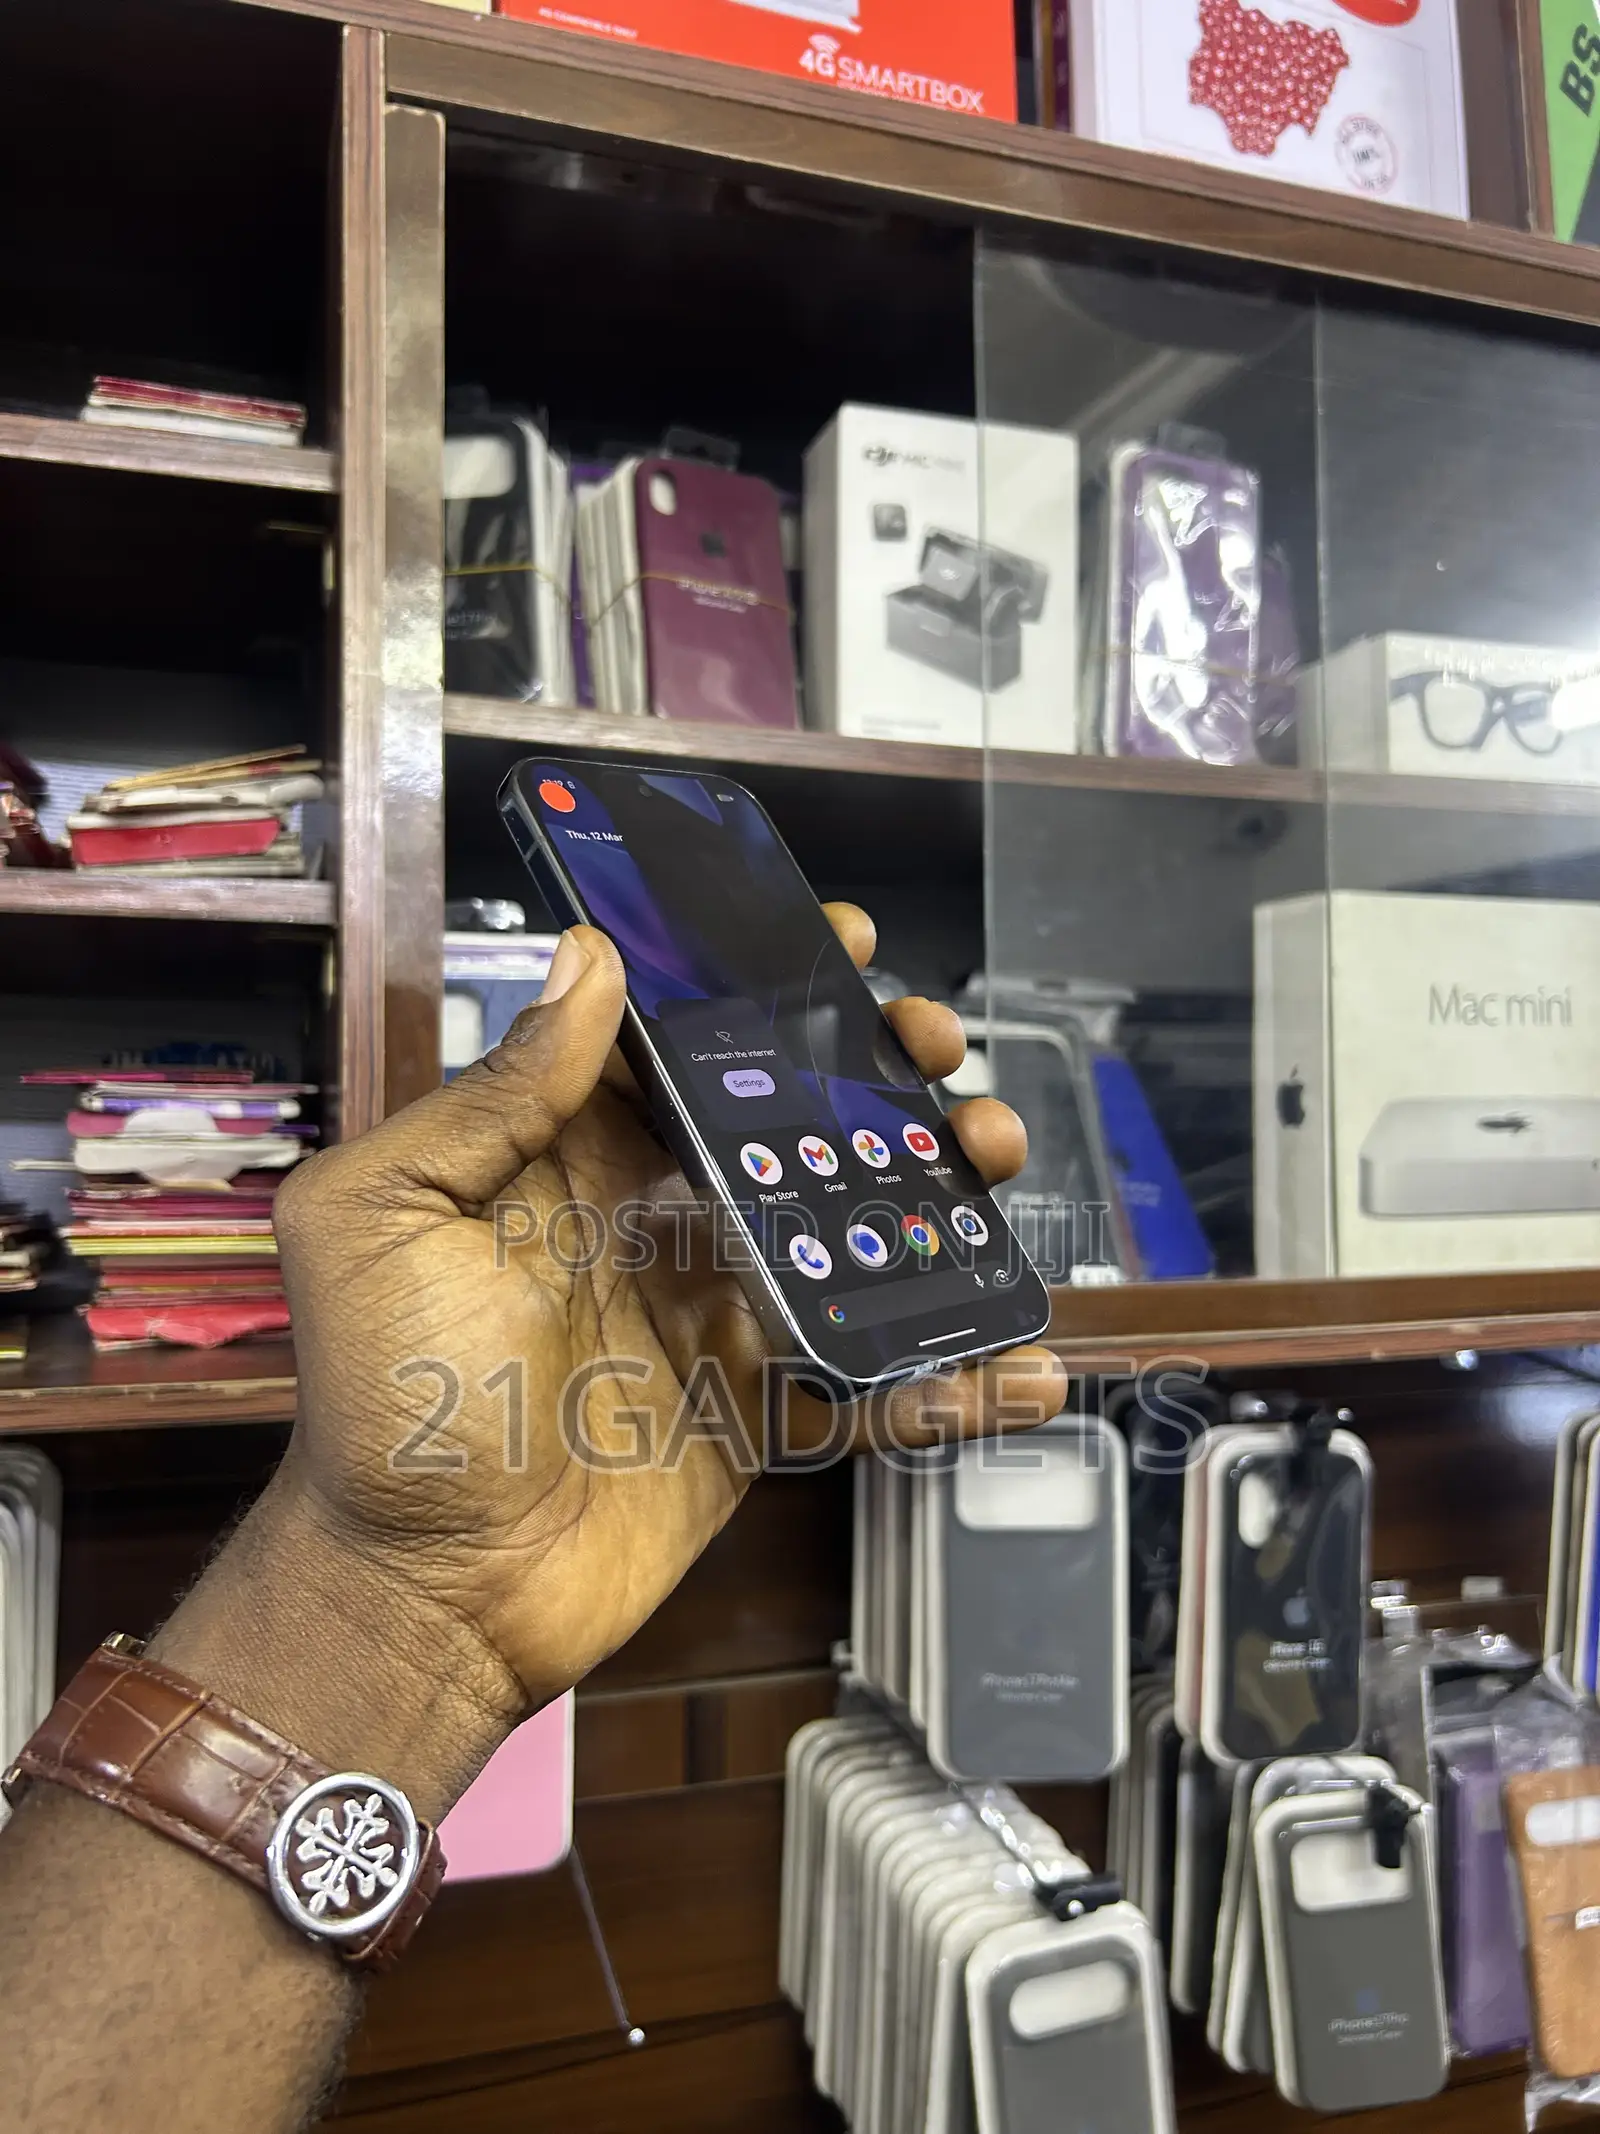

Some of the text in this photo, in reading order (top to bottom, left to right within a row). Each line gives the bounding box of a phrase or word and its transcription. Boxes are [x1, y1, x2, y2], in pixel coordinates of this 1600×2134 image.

[799, 48, 837, 79] 4G
[837, 55, 986, 114] SMARTBOX
[565, 829, 624, 842] Thu, 12 Mar
[1428, 982, 1574, 1028] Mac mini
[691, 1048, 777, 1062] Can't reach the internet
[732, 1079, 766, 1088] Settings
[923, 1166, 953, 1177] YouTube
[875, 1173, 902, 1185] Photos
[824, 1181, 848, 1193] Gmail
[758, 1190, 800, 1204] Play Store
